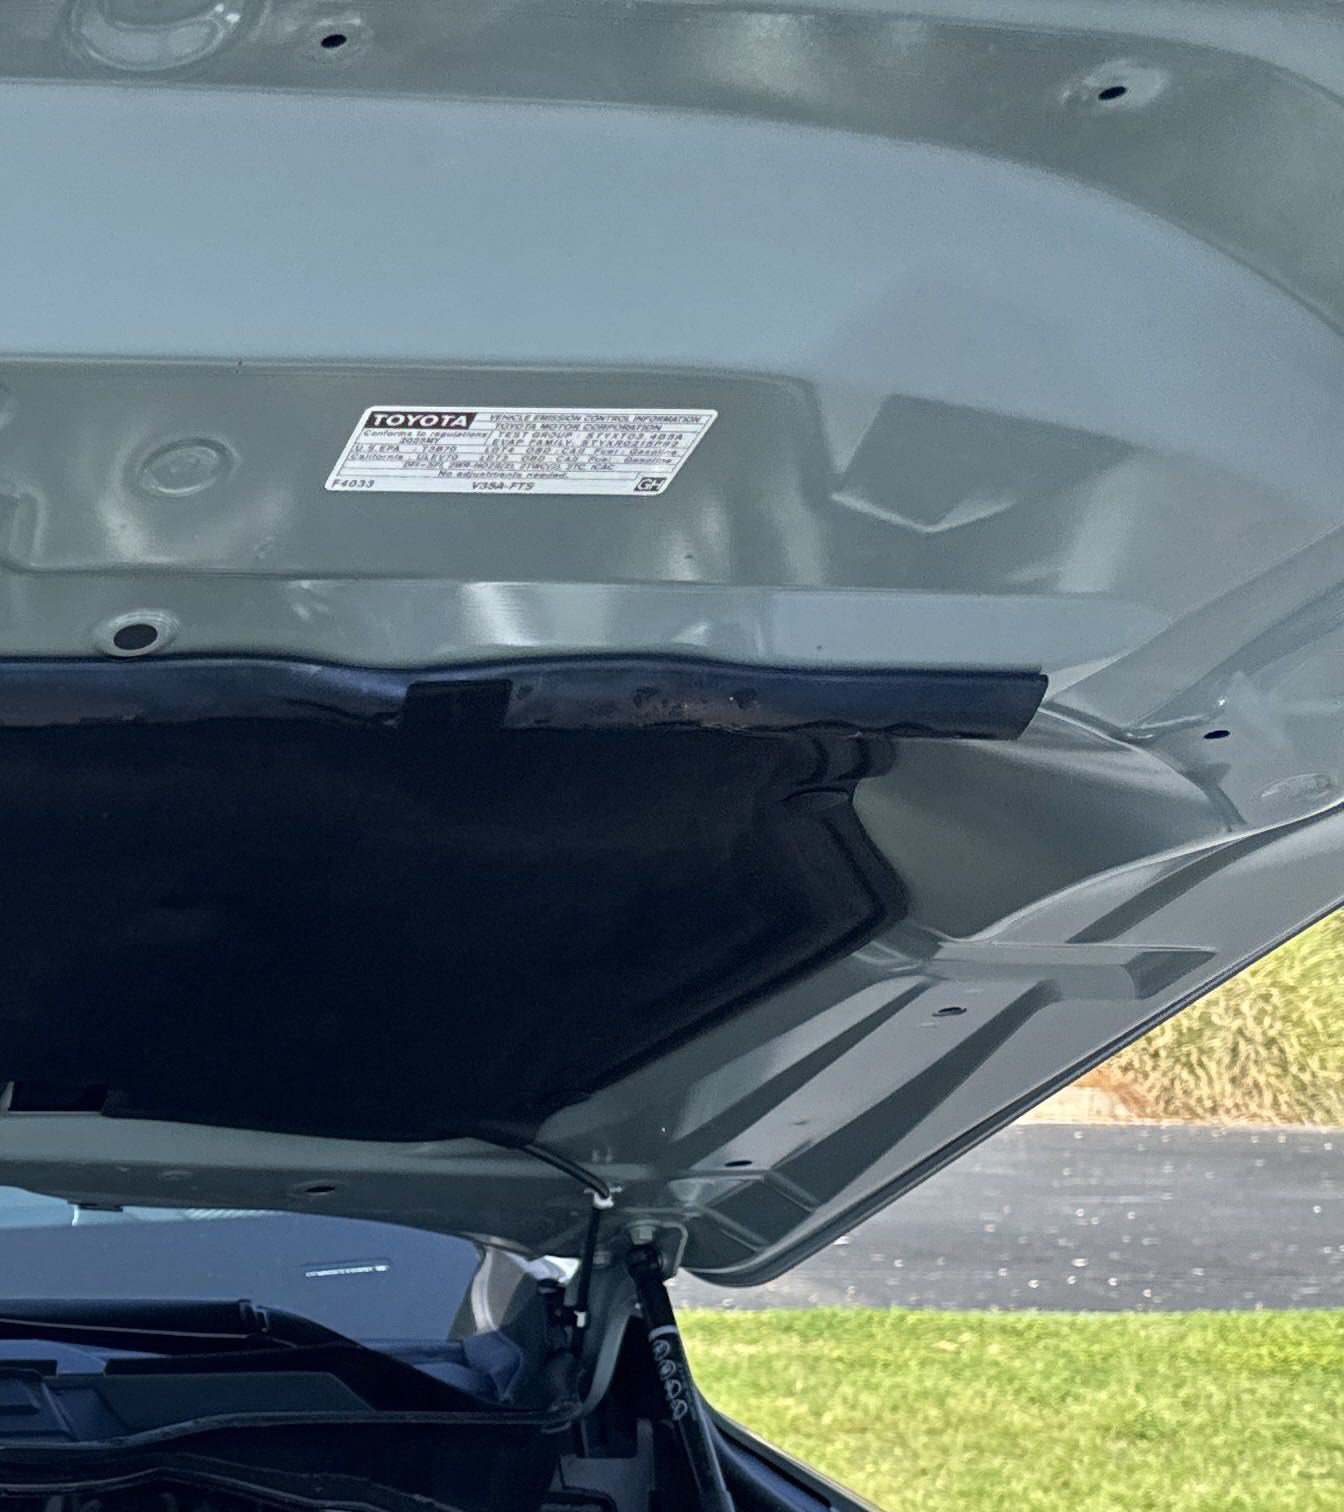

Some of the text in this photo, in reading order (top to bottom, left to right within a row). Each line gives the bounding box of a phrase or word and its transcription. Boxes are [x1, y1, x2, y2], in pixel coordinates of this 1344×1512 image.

[372, 413, 469, 427] TOYOTA
[490, 414, 529, 422] VEHICLE
[632, 415, 702, 423] INFORMATION
[582, 423, 663, 431] CORPORATION
[492, 439, 524, 447] EVAP
[637, 478, 664, 491] GH
